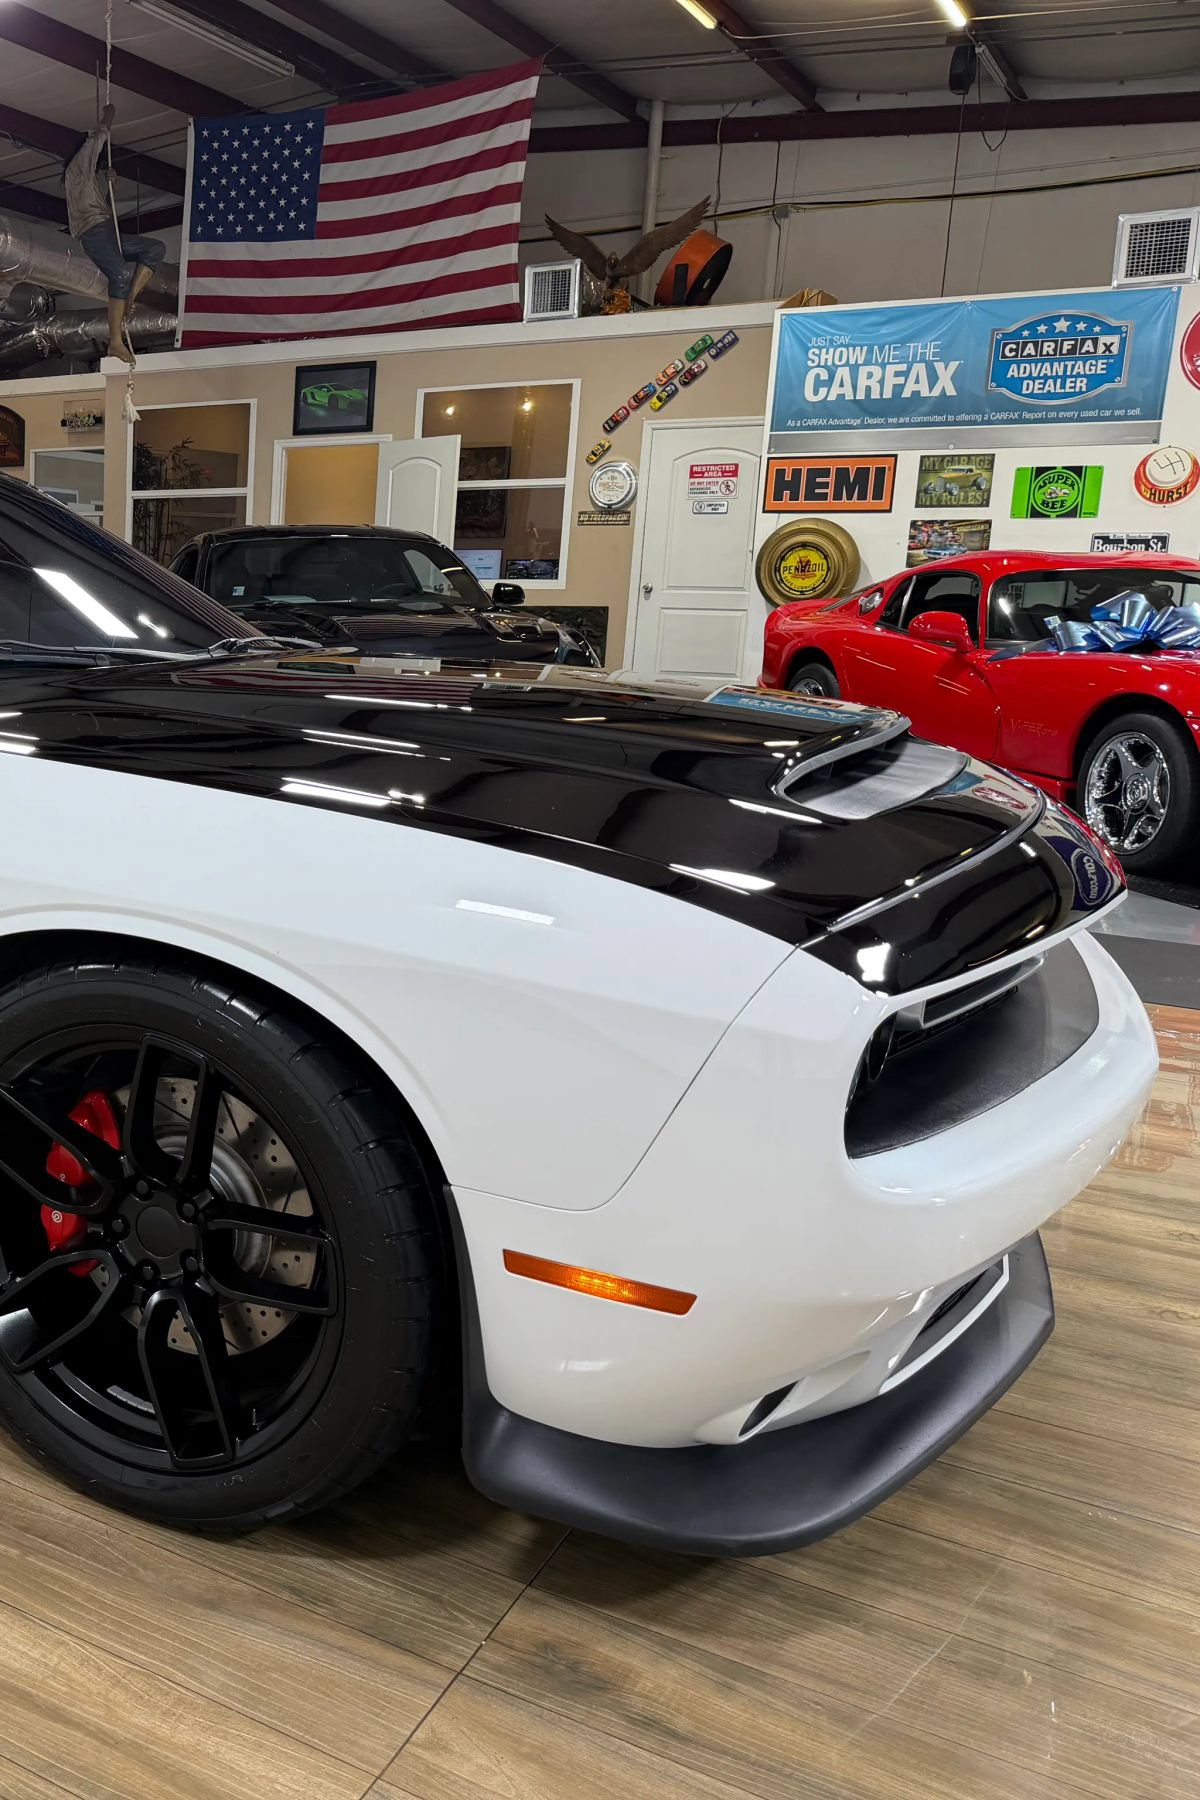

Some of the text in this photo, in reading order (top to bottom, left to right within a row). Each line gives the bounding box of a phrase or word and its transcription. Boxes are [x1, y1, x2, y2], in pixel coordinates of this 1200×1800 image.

[808, 336, 850, 346] JUST SAY
[1003, 338, 1117, 358] CARFAX
[807, 341, 942, 366] SHOW ME THE
[804, 361, 960, 402] CARFAX
[1022, 378, 1088, 394] DEALER
[786, 419, 796, 427] As
[910, 414, 946, 423] committed
[948, 414, 954, 422] to
[956, 412, 982, 422] offering
[1022, 411, 1046, 420] Report
[1080, 409, 1098, 417] used
[1126, 408, 1142, 416] sell.
[922, 455, 992, 470] MY GARAGE
[772, 466, 888, 502] HEMI
[1038, 474, 1076, 490] SUPER
[918, 491, 988, 505] MY RULES!
[1149, 482, 1190, 502] HURST
[1040, 499, 1068, 510] BEE
[1093, 538, 1167, 552] Bourbon St.
